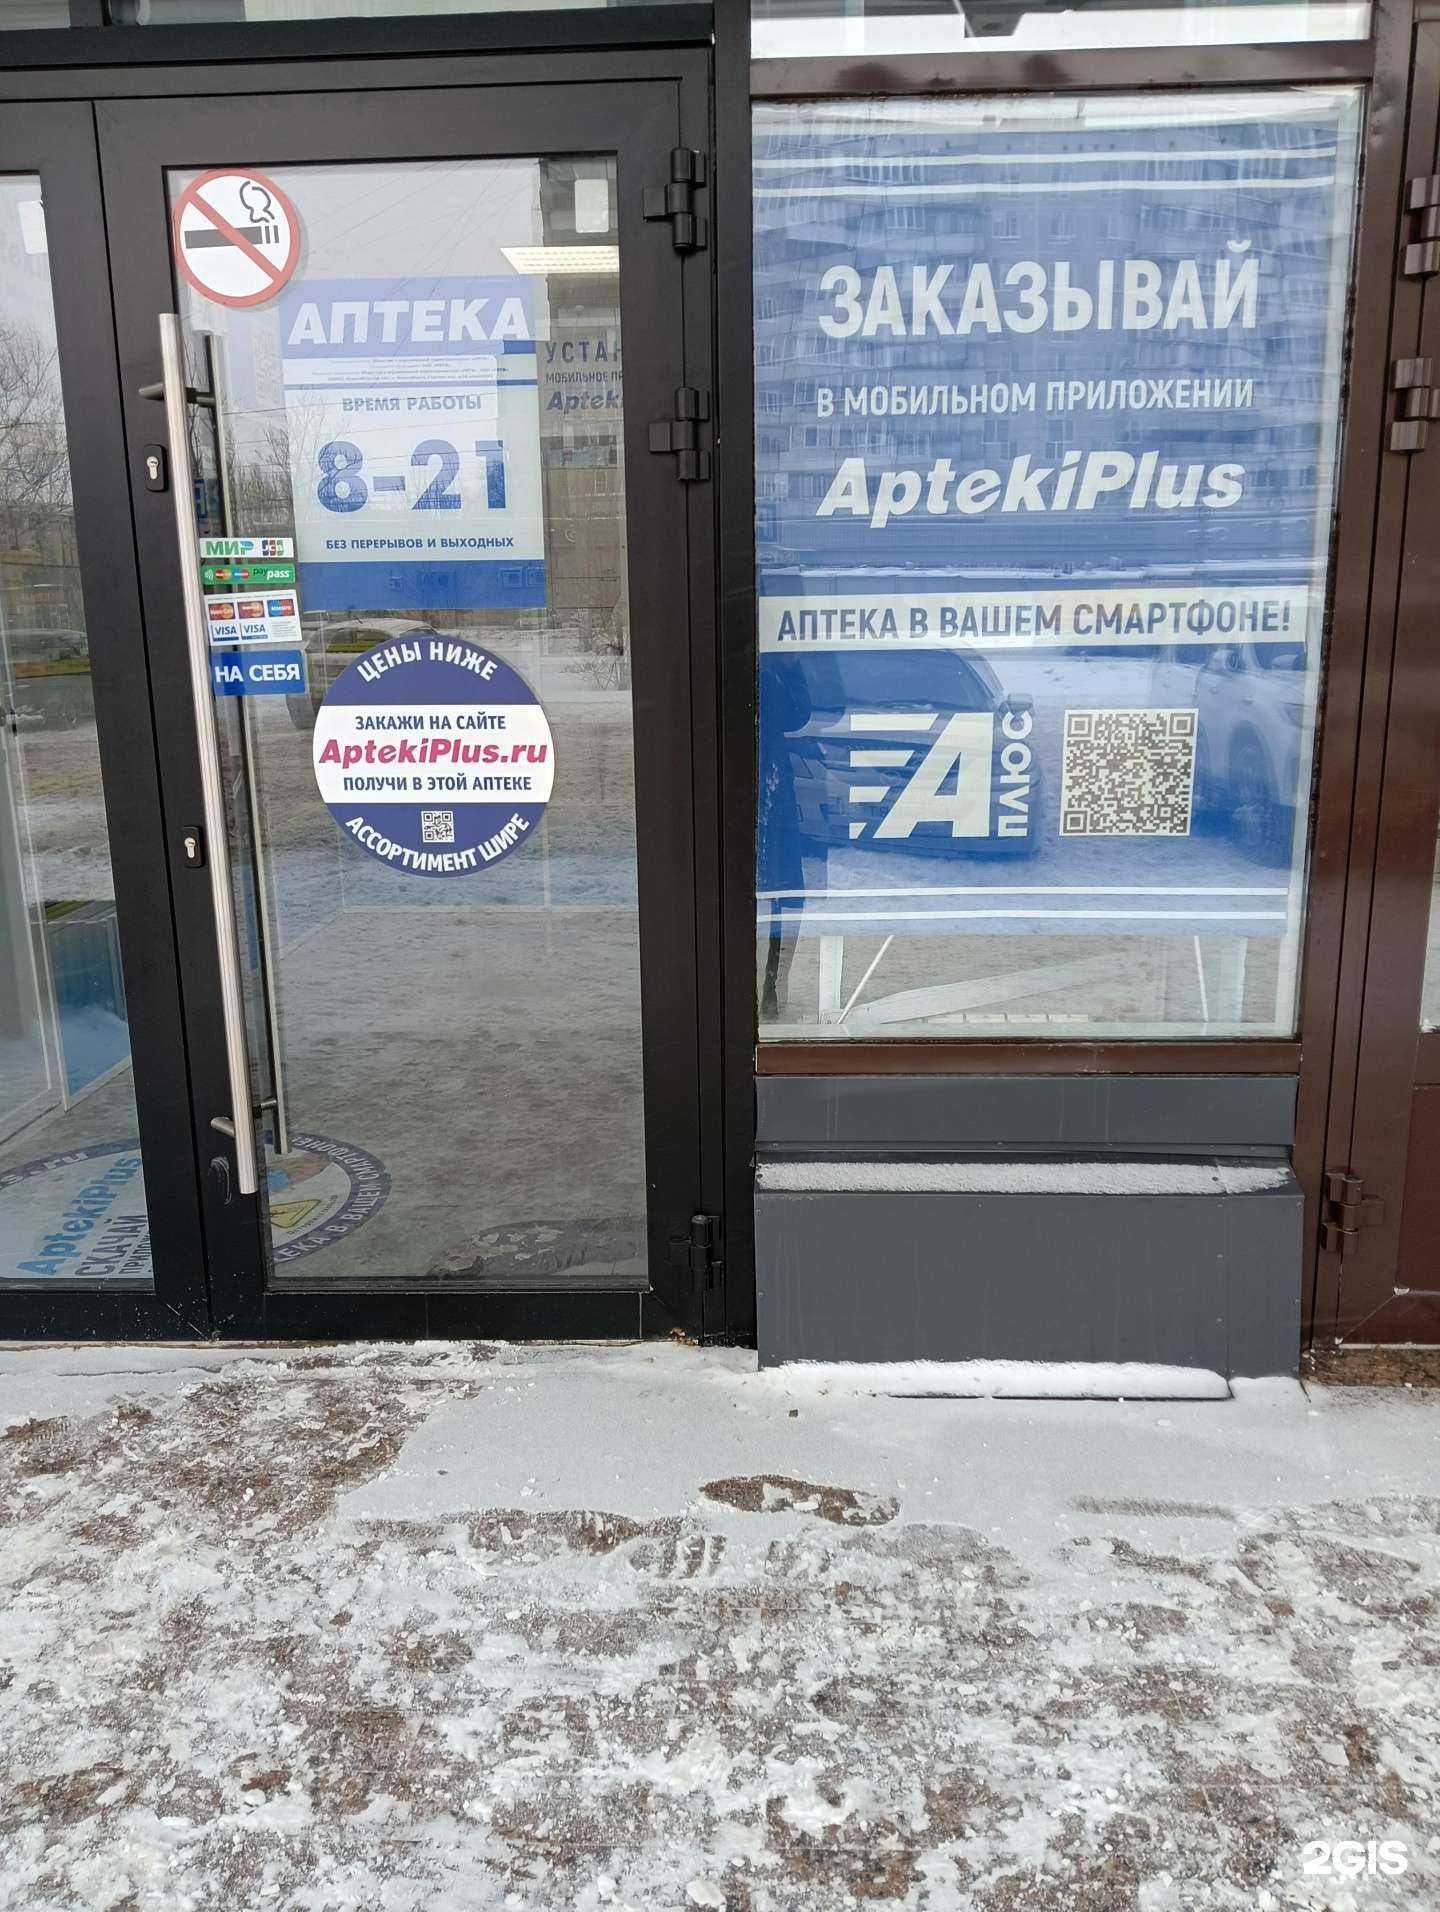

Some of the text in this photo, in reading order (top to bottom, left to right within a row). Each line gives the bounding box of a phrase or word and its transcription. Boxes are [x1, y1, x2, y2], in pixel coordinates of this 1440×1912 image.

[817, 239, 1261, 339] ЗАКАЗЫВАЙ
[287, 297, 531, 345] АПТЕКА
[545, 371, 608, 384] МОБИЛЬНОЕ
[342, 395, 482, 412] ВРЕМЯ РАБОТЫ
[545, 390, 623, 415] Aptek
[816, 377, 1255, 417] В МОБИЛЬНОМ ПРИЛОЖЕНИИ
[316, 439, 507, 513] 8-21
[816, 450, 1246, 528] AptekiPlus
[205, 541, 254, 556] МИР
[325, 536, 514, 550] БЕЗ ПЕРЕРЫВОВ И ВЫХОДНЫХ
[215, 626, 237, 636] VISA
[243, 624, 266, 634] VISA
[777, 599, 1290, 641] АПТЕКА В ВАШЕМ СМАРТФОНЕ!
[214, 663, 301, 683] НА СЕБЯ
[356, 640, 499, 684] ЦЕНЫ НИЖЕ
[355, 713, 506, 731] ЗАКАЖИ НА САЙТЕ
[318, 738, 548, 769] AptekiPlus.ru
[343, 774, 532, 792] ПОЛУЧИ В ЭТОЙ АПТЕКЕ
[997, 710, 1033, 837] ПЛЮС
[345, 813, 531, 873] АССОРТИМЕНТ ШИРЕ
